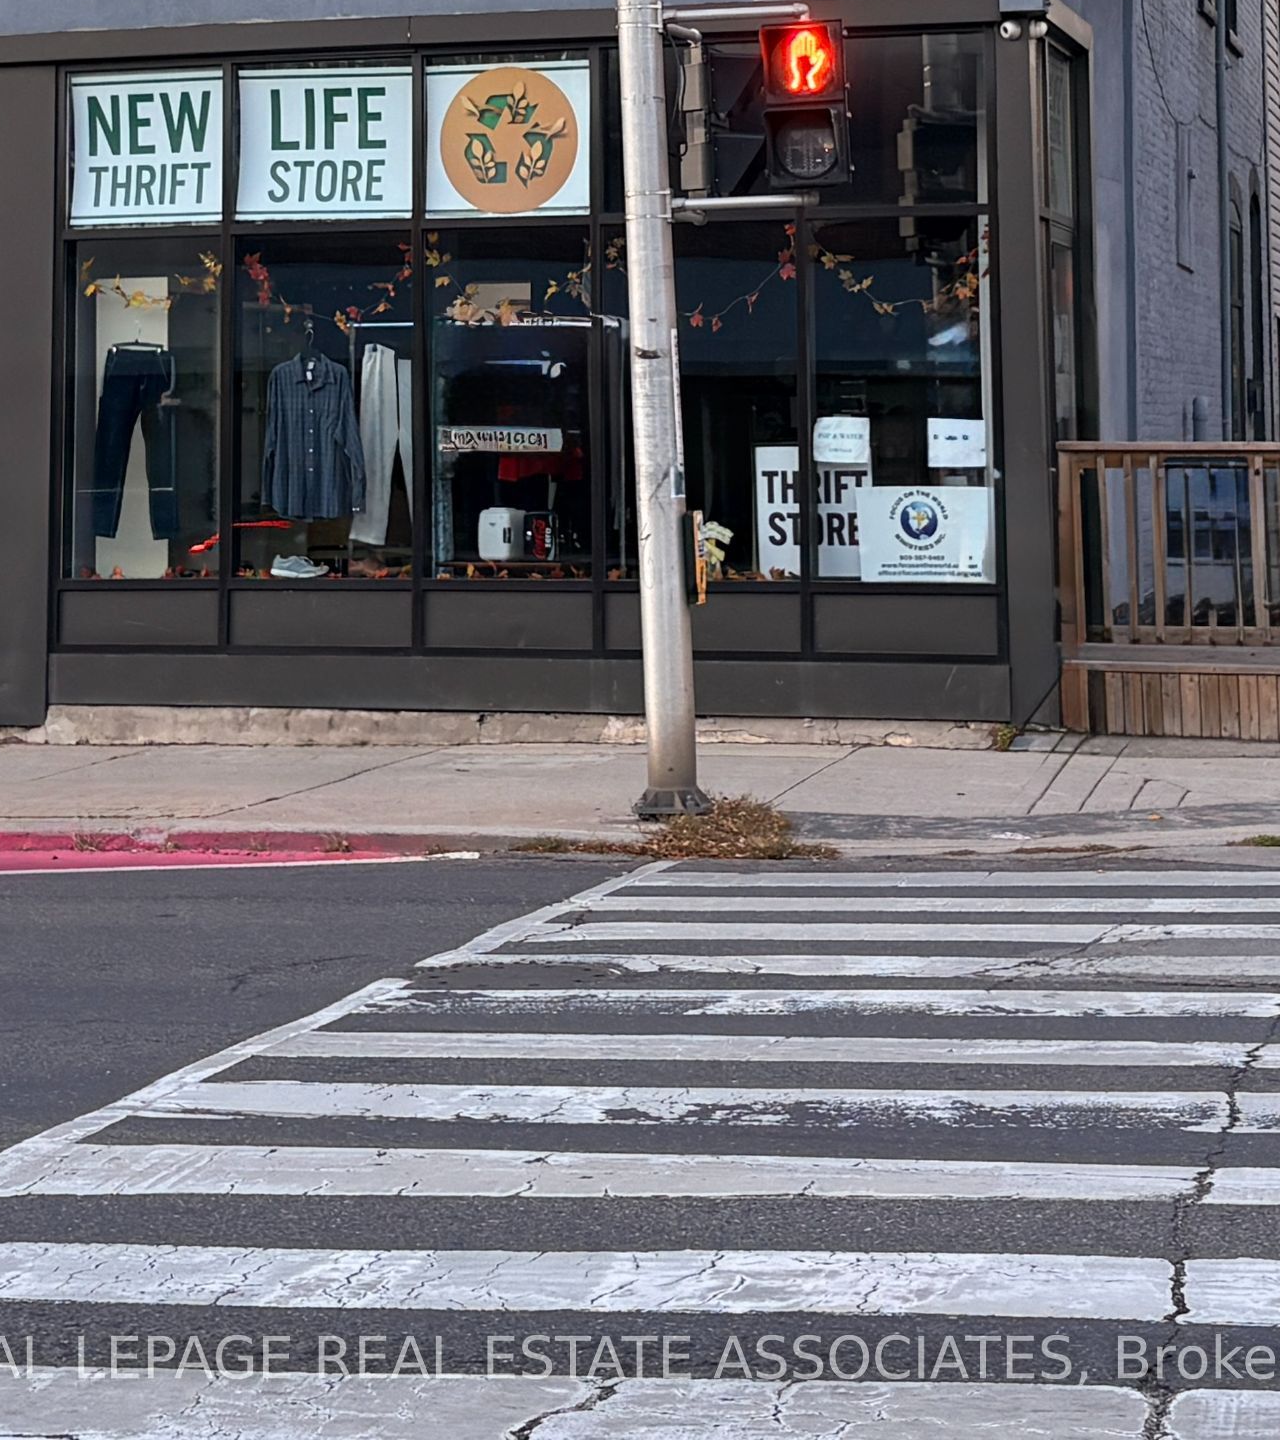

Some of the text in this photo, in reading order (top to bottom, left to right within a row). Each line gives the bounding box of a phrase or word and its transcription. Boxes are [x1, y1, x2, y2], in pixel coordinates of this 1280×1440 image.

[87, 87, 387, 156] NEW LIFE
[89, 159, 386, 207] THRIFT STORE
[761, 470, 868, 504] THIFT
[915, 489, 931, 499] THE
[768, 511, 860, 546] STRE
